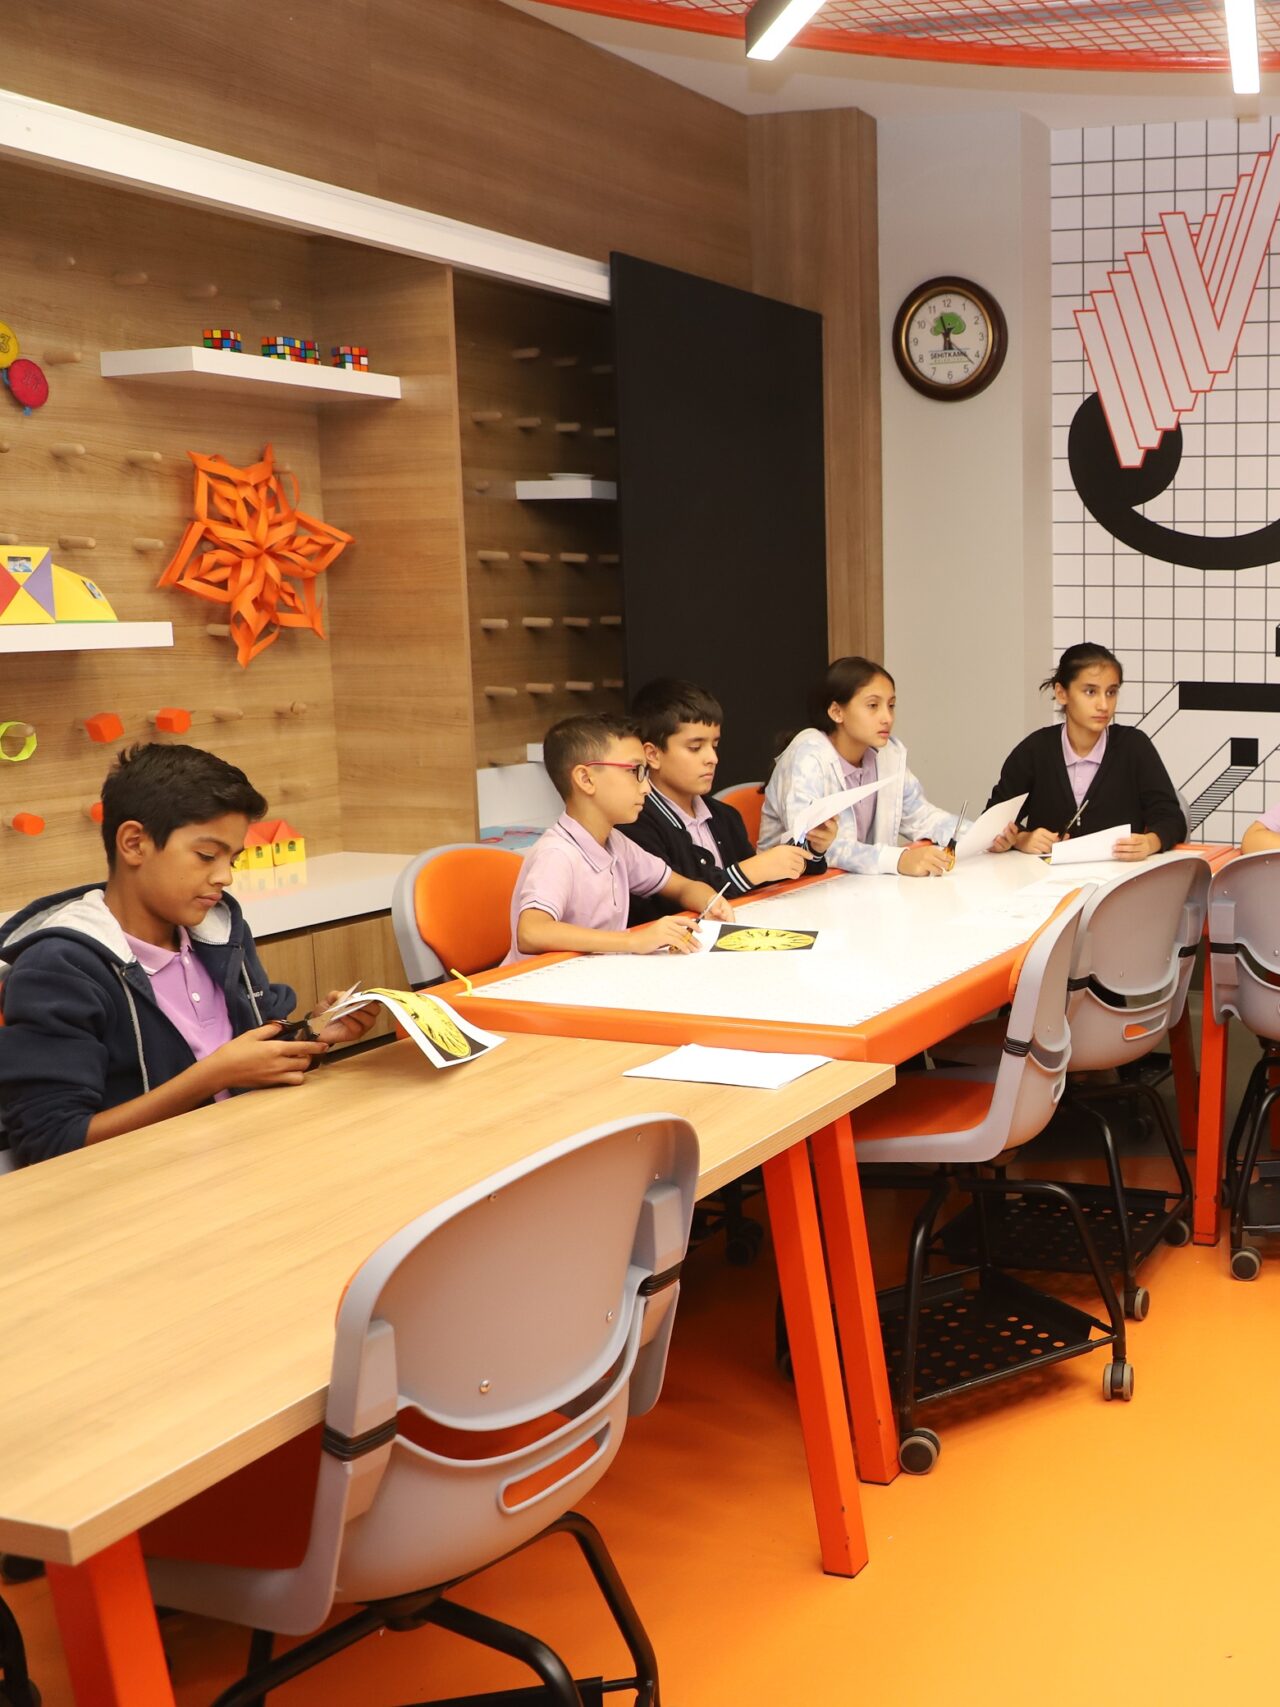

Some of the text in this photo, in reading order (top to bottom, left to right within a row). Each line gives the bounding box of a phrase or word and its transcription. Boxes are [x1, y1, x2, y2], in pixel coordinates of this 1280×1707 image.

[942, 299, 951, 308] 12
[929, 305, 936, 314] 11
[917, 320, 926, 329] 10
[974, 316, 979, 325] 2
[979, 332, 984, 341] 3
[913, 338, 919, 346] 9
[918, 354, 924, 363] 8
[974, 350, 980, 359] 4
[931, 367, 937, 376] 7
[963, 365, 969, 374] 5
[947, 371, 953, 380] 6
